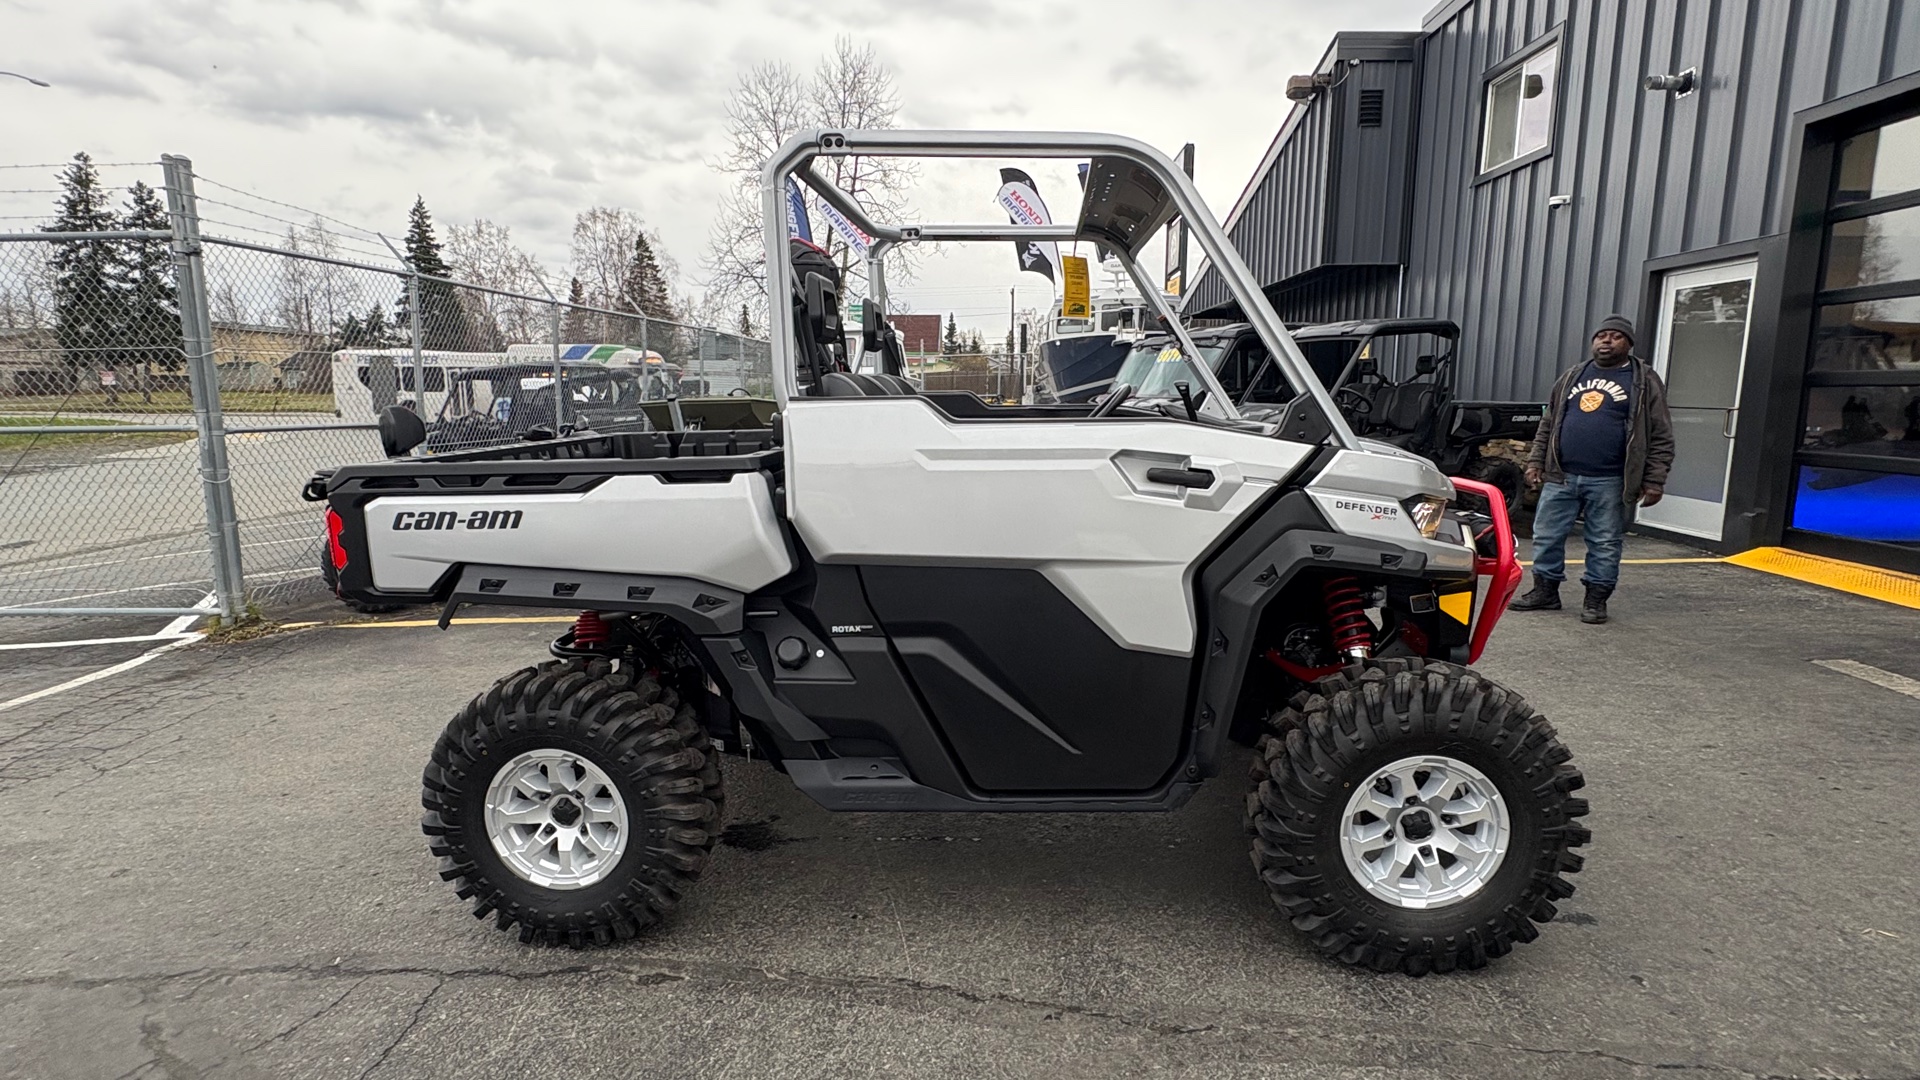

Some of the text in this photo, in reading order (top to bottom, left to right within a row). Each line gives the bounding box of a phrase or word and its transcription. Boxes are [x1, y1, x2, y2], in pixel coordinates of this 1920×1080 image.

[1010, 190, 1043, 225] HOND
[821, 203, 867, 253] MARINE
[1336, 501, 1397, 516] DEFENDER
[392, 510, 523, 531] can-am
[831, 625, 862, 633] ROTAX
